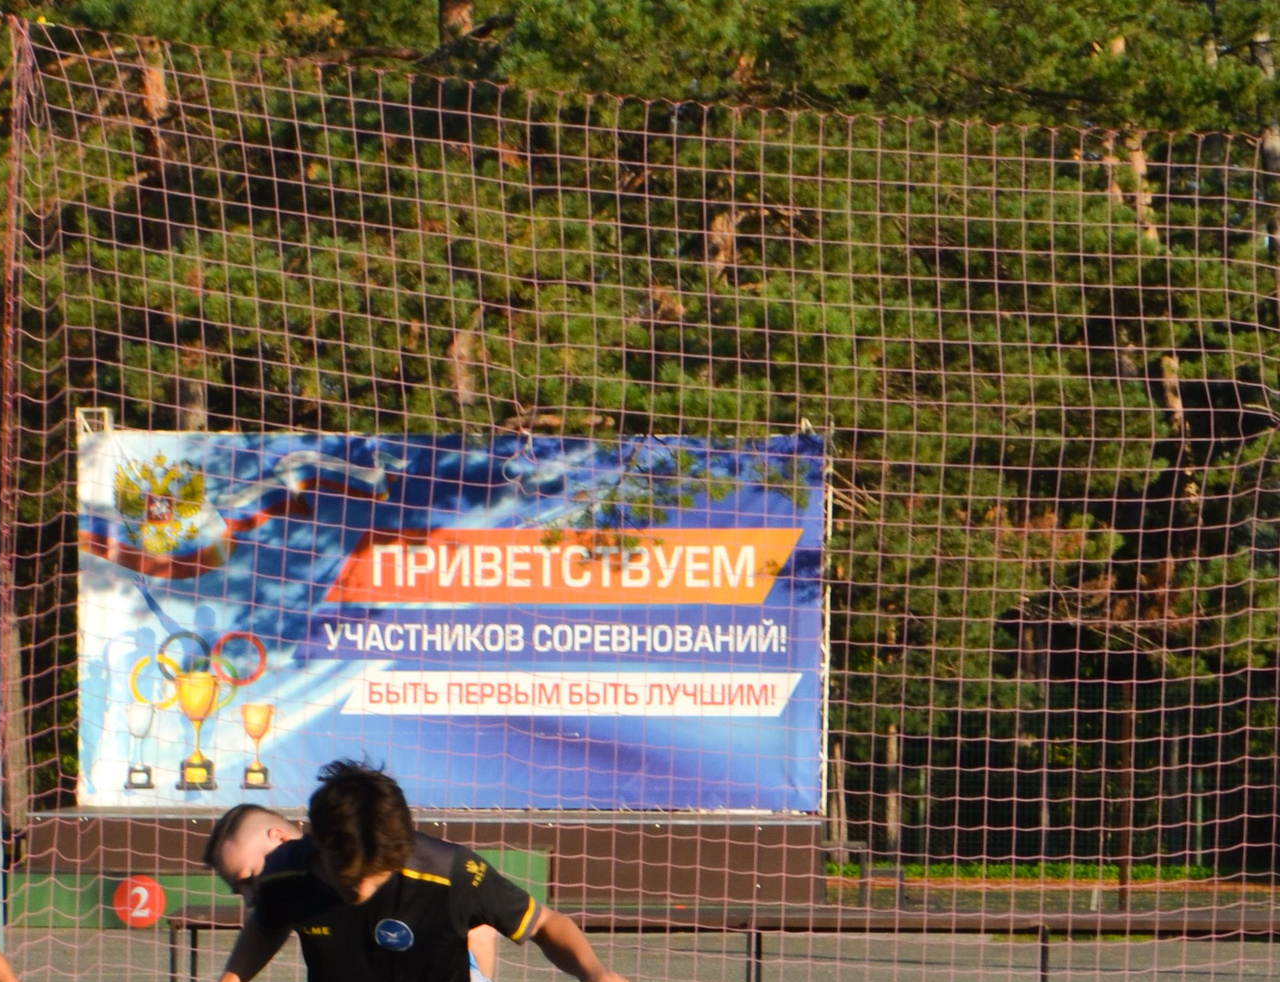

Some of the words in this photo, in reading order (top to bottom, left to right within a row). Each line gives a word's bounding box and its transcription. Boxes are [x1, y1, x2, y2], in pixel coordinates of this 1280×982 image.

[372, 544, 756, 589] ПРИВЕТСТВУЕМ
[324, 623, 526, 653] УЧАСТНИКОВ
[532, 618, 788, 654] СОРЕВНОВАНИЙ!
[368, 681, 439, 705] БЫТЬ
[447, 682, 561, 706] ПЕРВЫМ
[568, 683, 639, 706] БЫТЬ
[645, 683, 776, 707] ЛУЧШИМ!
[130, 886, 151, 918] 2
